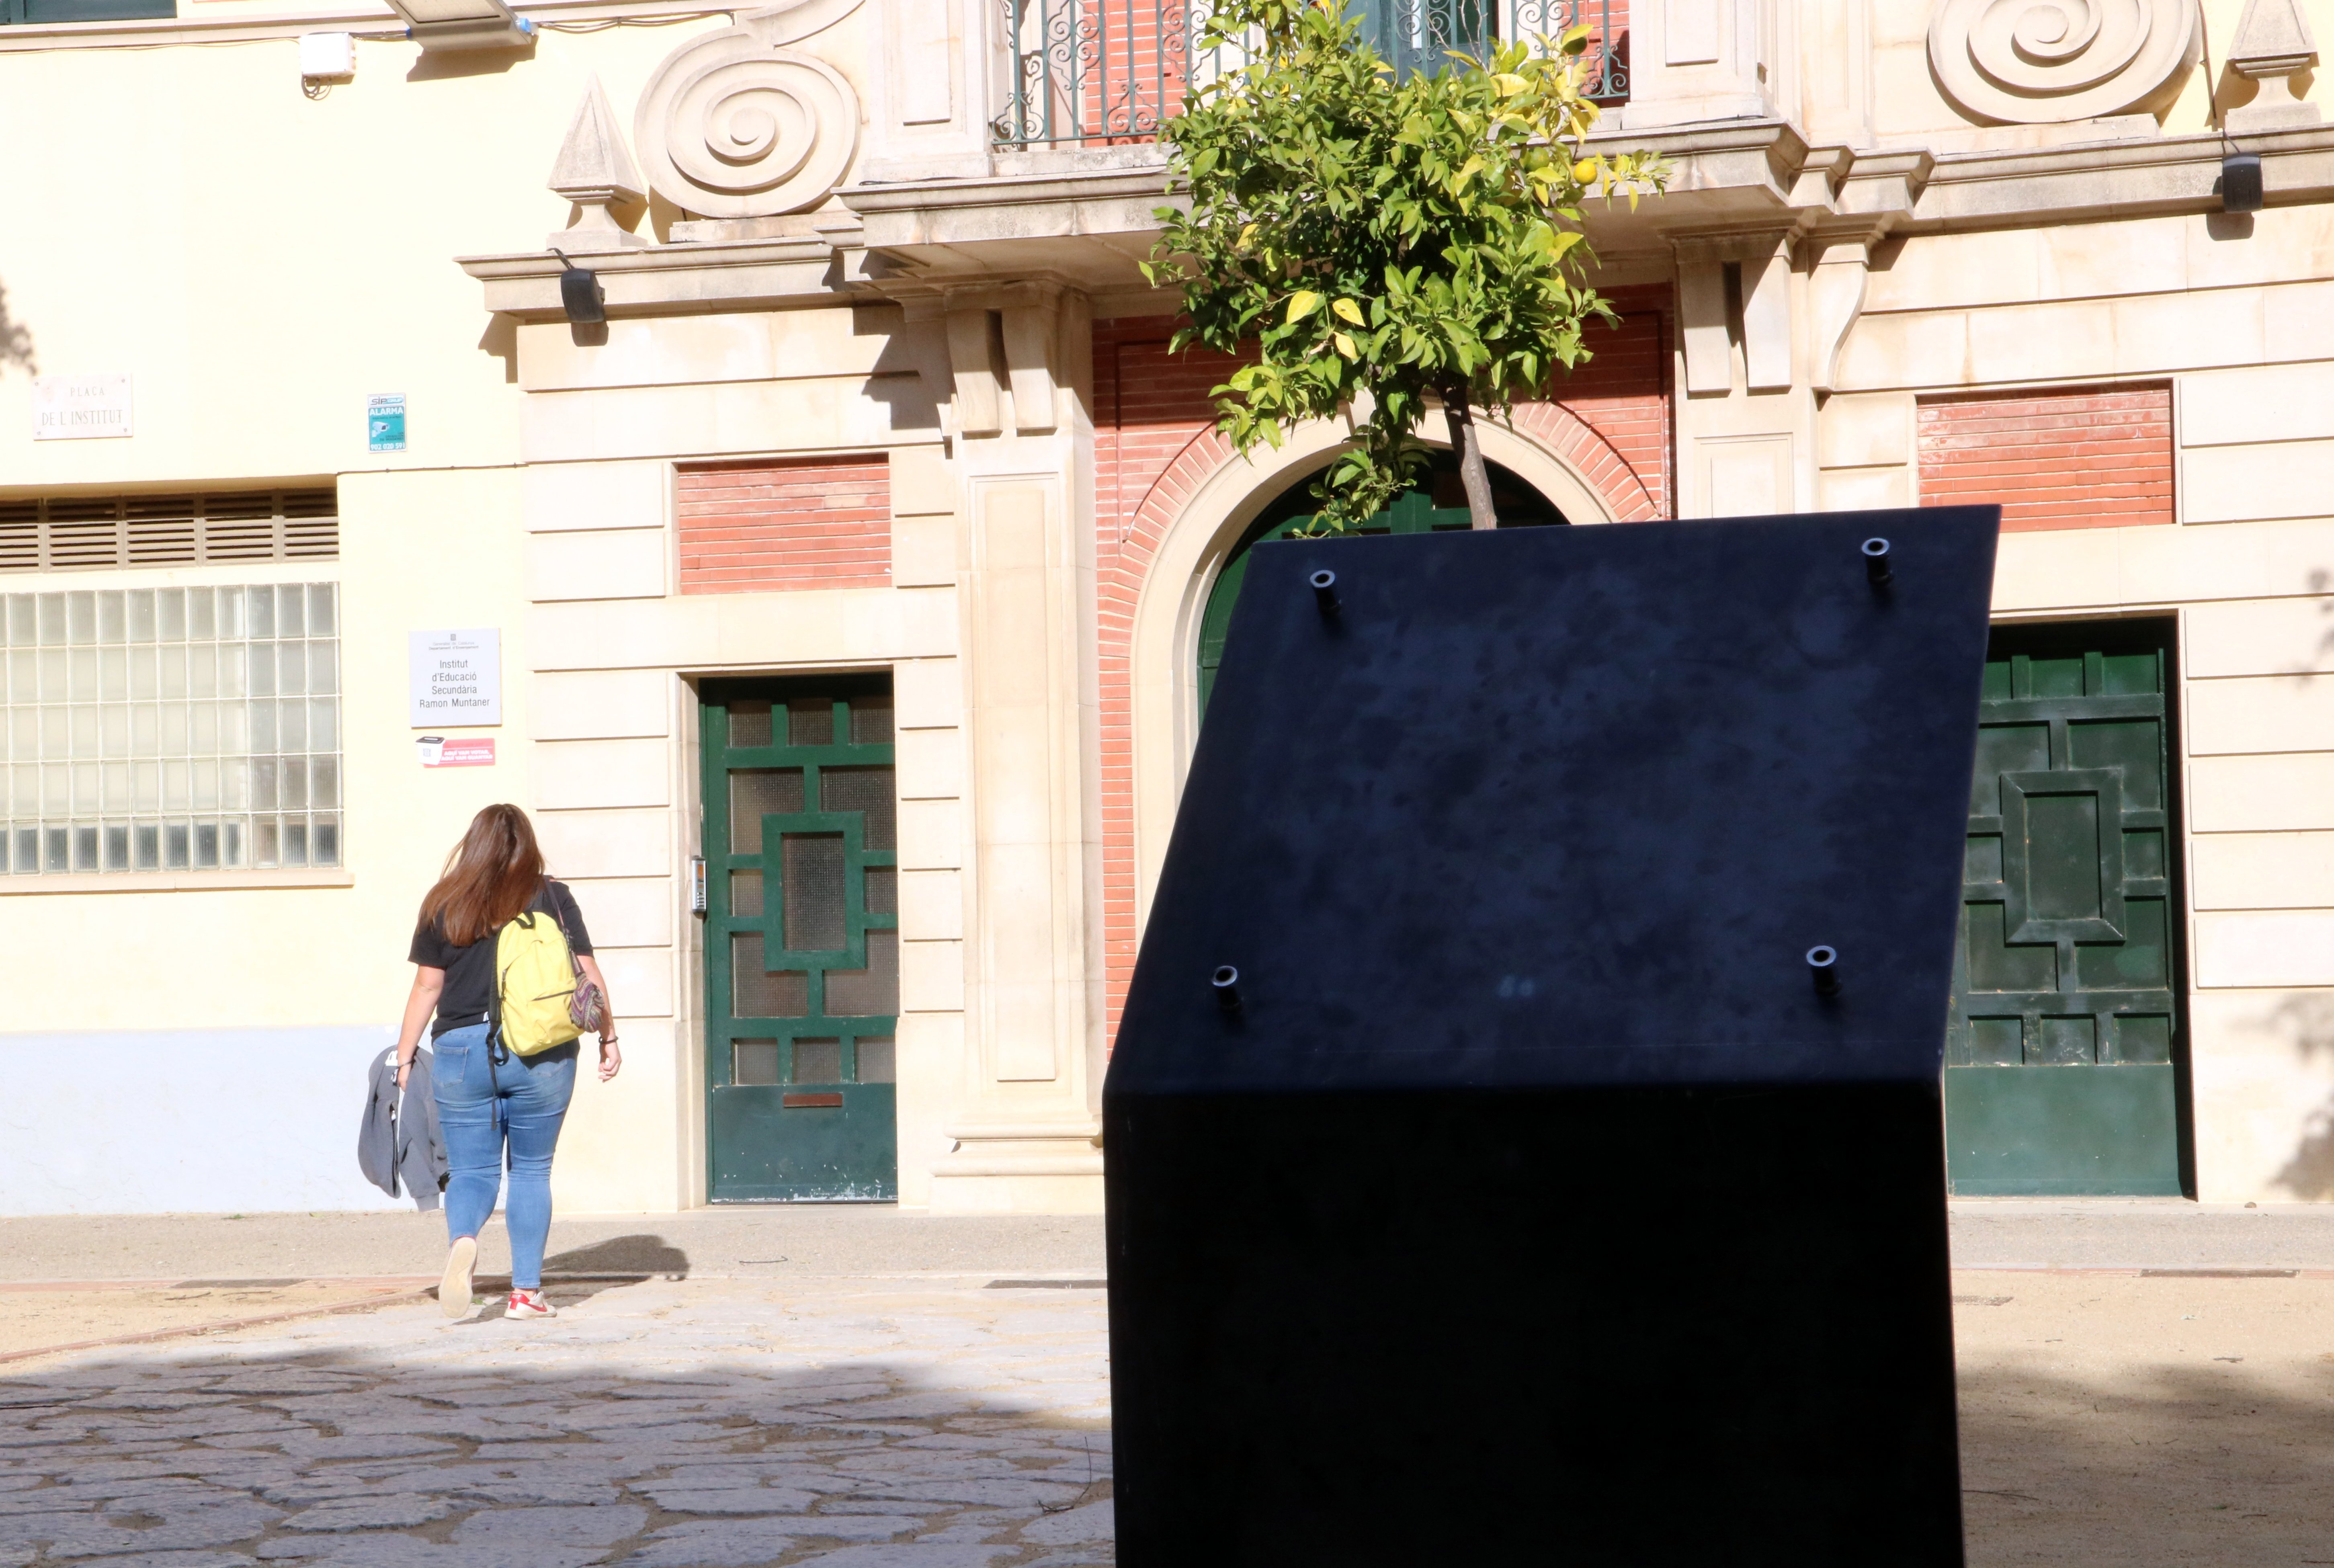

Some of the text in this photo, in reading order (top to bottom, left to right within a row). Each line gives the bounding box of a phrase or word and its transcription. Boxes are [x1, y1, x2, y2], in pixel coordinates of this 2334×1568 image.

[371, 397, 387, 405] SIP
[370, 407, 404, 416] ALARMA
[42, 412, 55, 426] DE
[71, 409, 123, 425] INSTITUT
[440, 660, 468, 668] Institut
[432, 672, 477, 682] d'Educació
[432, 685, 477, 695] Secundària
[420, 698, 490, 708] Ramon Muntaner
